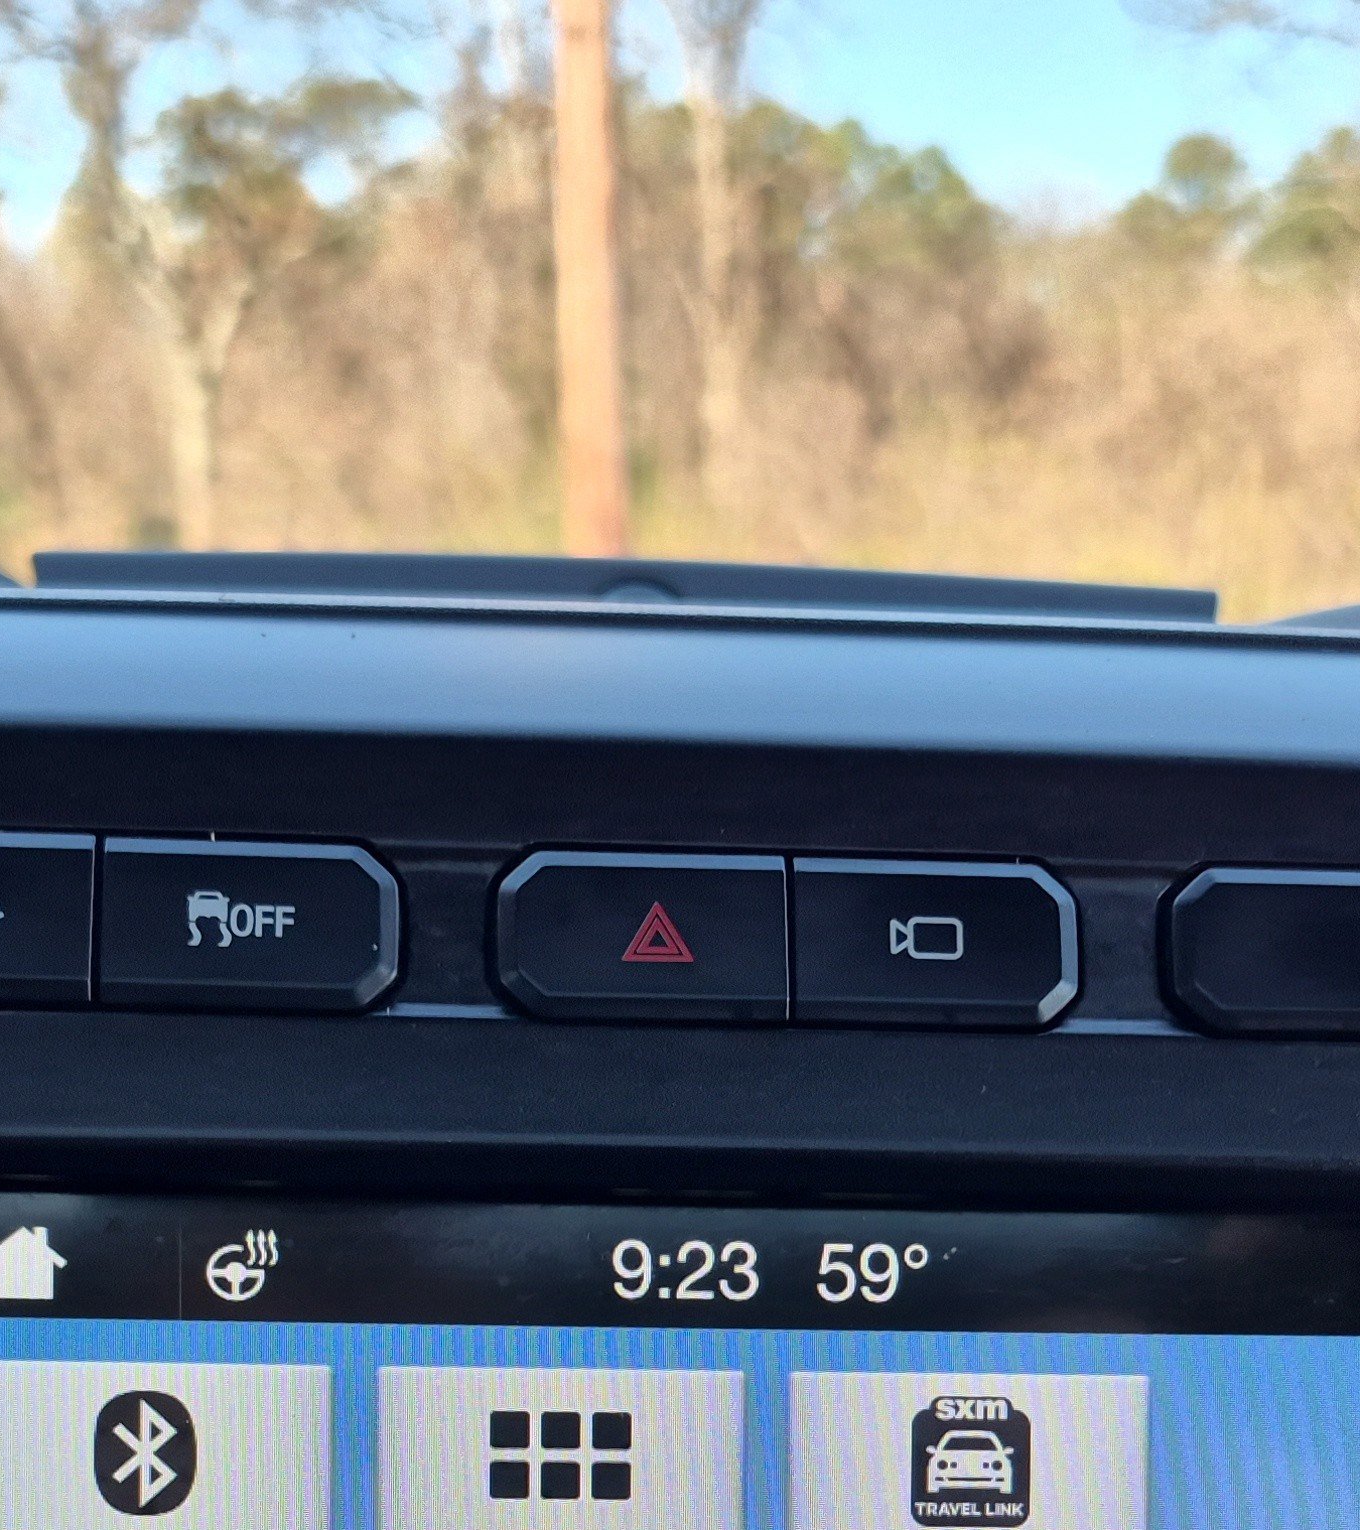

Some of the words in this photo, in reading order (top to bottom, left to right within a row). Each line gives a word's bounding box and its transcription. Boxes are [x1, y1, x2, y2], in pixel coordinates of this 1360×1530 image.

[230, 903, 295, 939] OFF
[612, 1238, 760, 1302] 9:23
[815, 1240, 928, 1304] 59°
[915, 1501, 981, 1518] TRAVEL
[985, 1501, 1024, 1518] LINK
